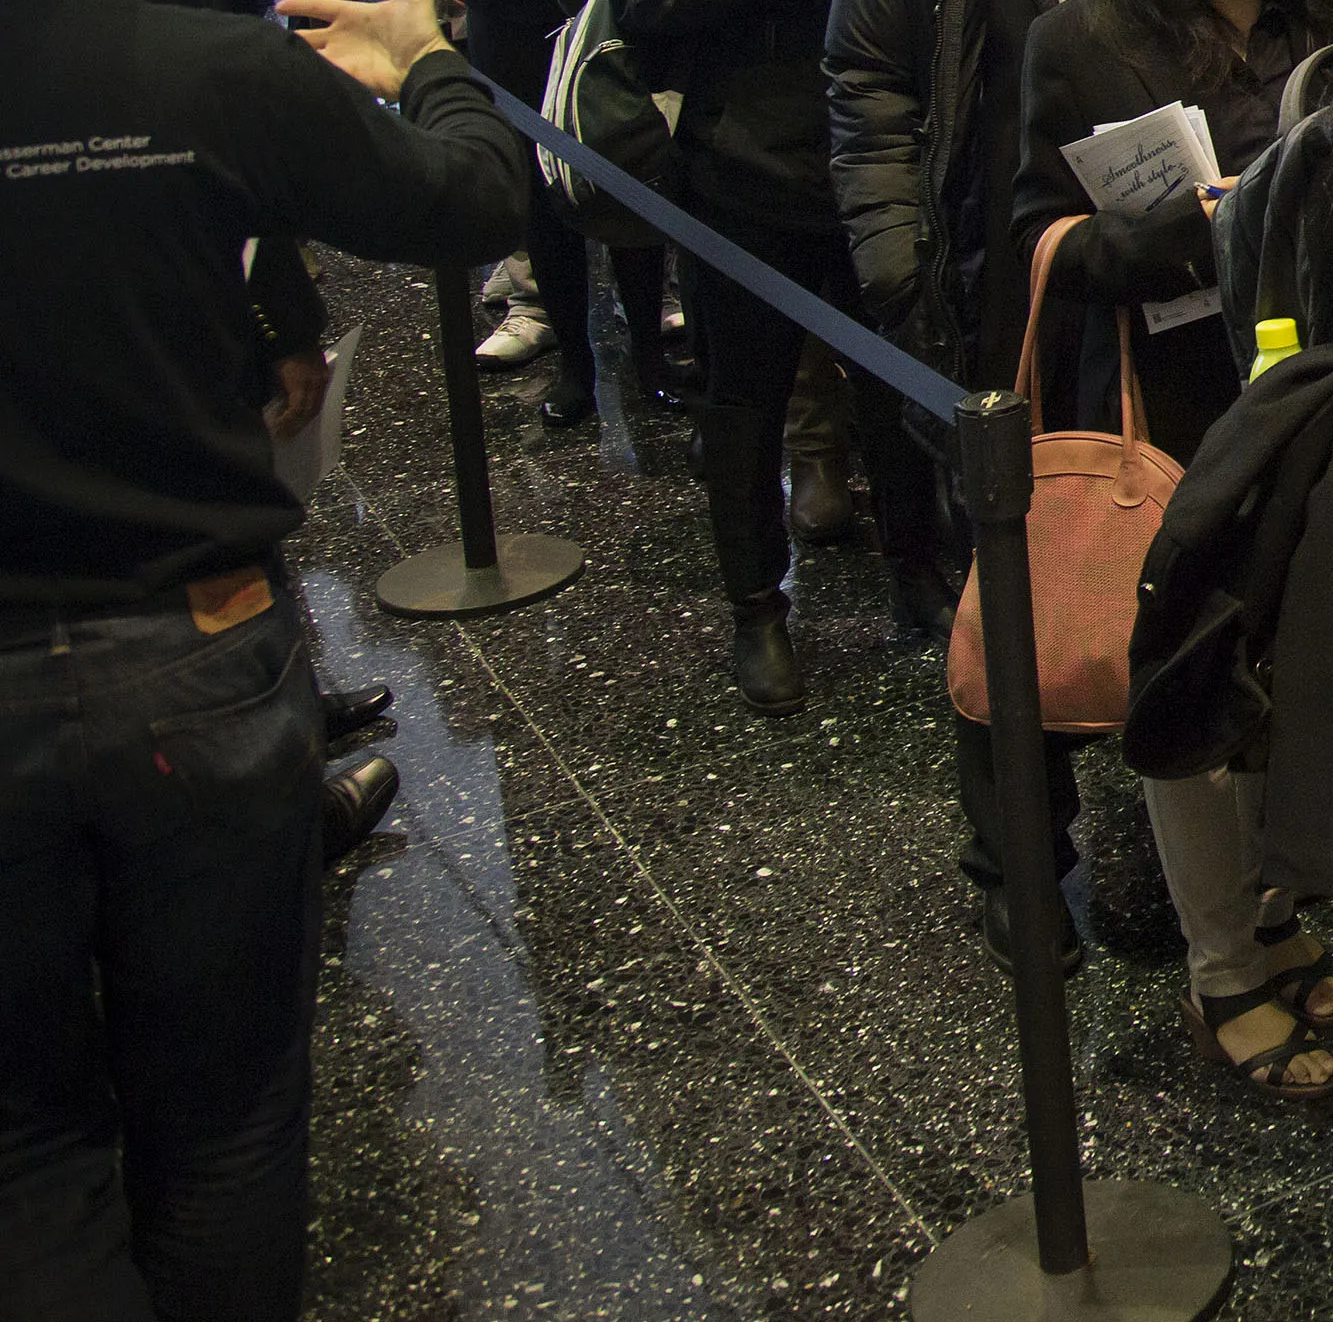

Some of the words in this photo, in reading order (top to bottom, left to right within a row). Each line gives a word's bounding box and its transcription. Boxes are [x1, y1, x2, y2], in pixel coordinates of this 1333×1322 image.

[0, 141, 84, 160] sserman
[88, 135, 151, 152] Center
[6, 161, 71, 179] Career
[76, 150, 196, 173] Development
